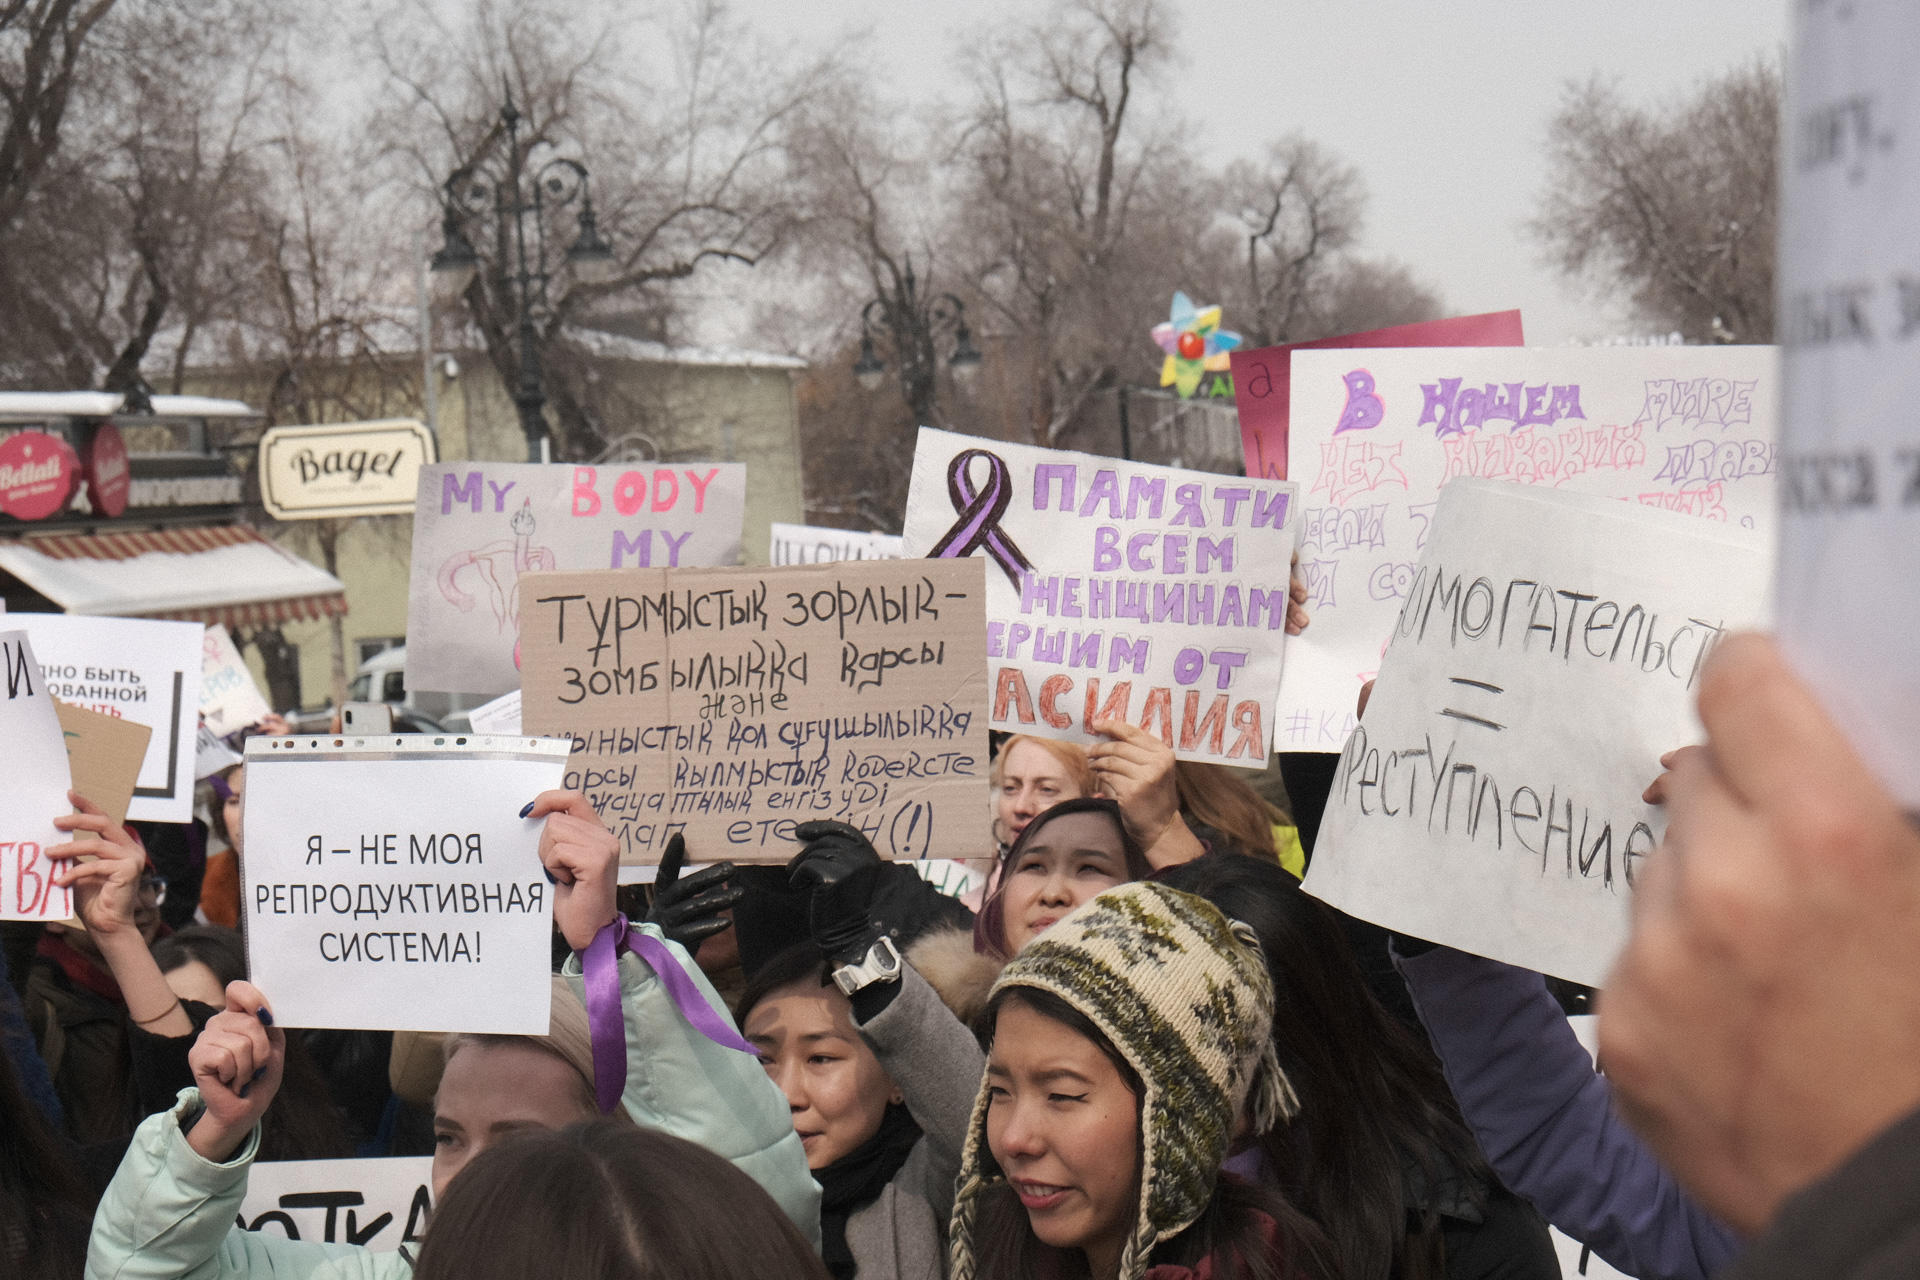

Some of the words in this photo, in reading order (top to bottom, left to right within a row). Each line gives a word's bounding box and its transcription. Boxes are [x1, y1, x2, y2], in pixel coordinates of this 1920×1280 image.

[1332, 367, 1386, 436] В
[1633, 377, 1760, 433] МИРЕ
[290, 448, 403, 483] Bagel
[1310, 435, 1409, 507] НЕТ
[441, 472, 516, 515] MY
[571, 466, 720, 517] BODY
[1032, 463, 1295, 530] ПАМЯТИ
[610, 528, 694, 569] MY
[1300, 502, 1390, 553] ЕСЛИ
[1093, 526, 1238, 575] ВСЕМ
[1020, 568, 1285, 631] ЖЕНЩИНАМ
[85, 667, 141, 684] БЫТЬ
[986, 618, 1155, 675] ЕРШИМ
[1173, 644, 1251, 690] ОТ
[543, 719, 712, 756] ыныстық
[564, 763, 637, 794] арсы
[306, 836, 321, 865] Я
[361, 835, 397, 864] НЕ
[410, 834, 482, 864] МОЯ
[256, 883, 543, 920] РЕПРОДУКТИВНАЯ
[319, 931, 481, 962] СИСТЕМА!
